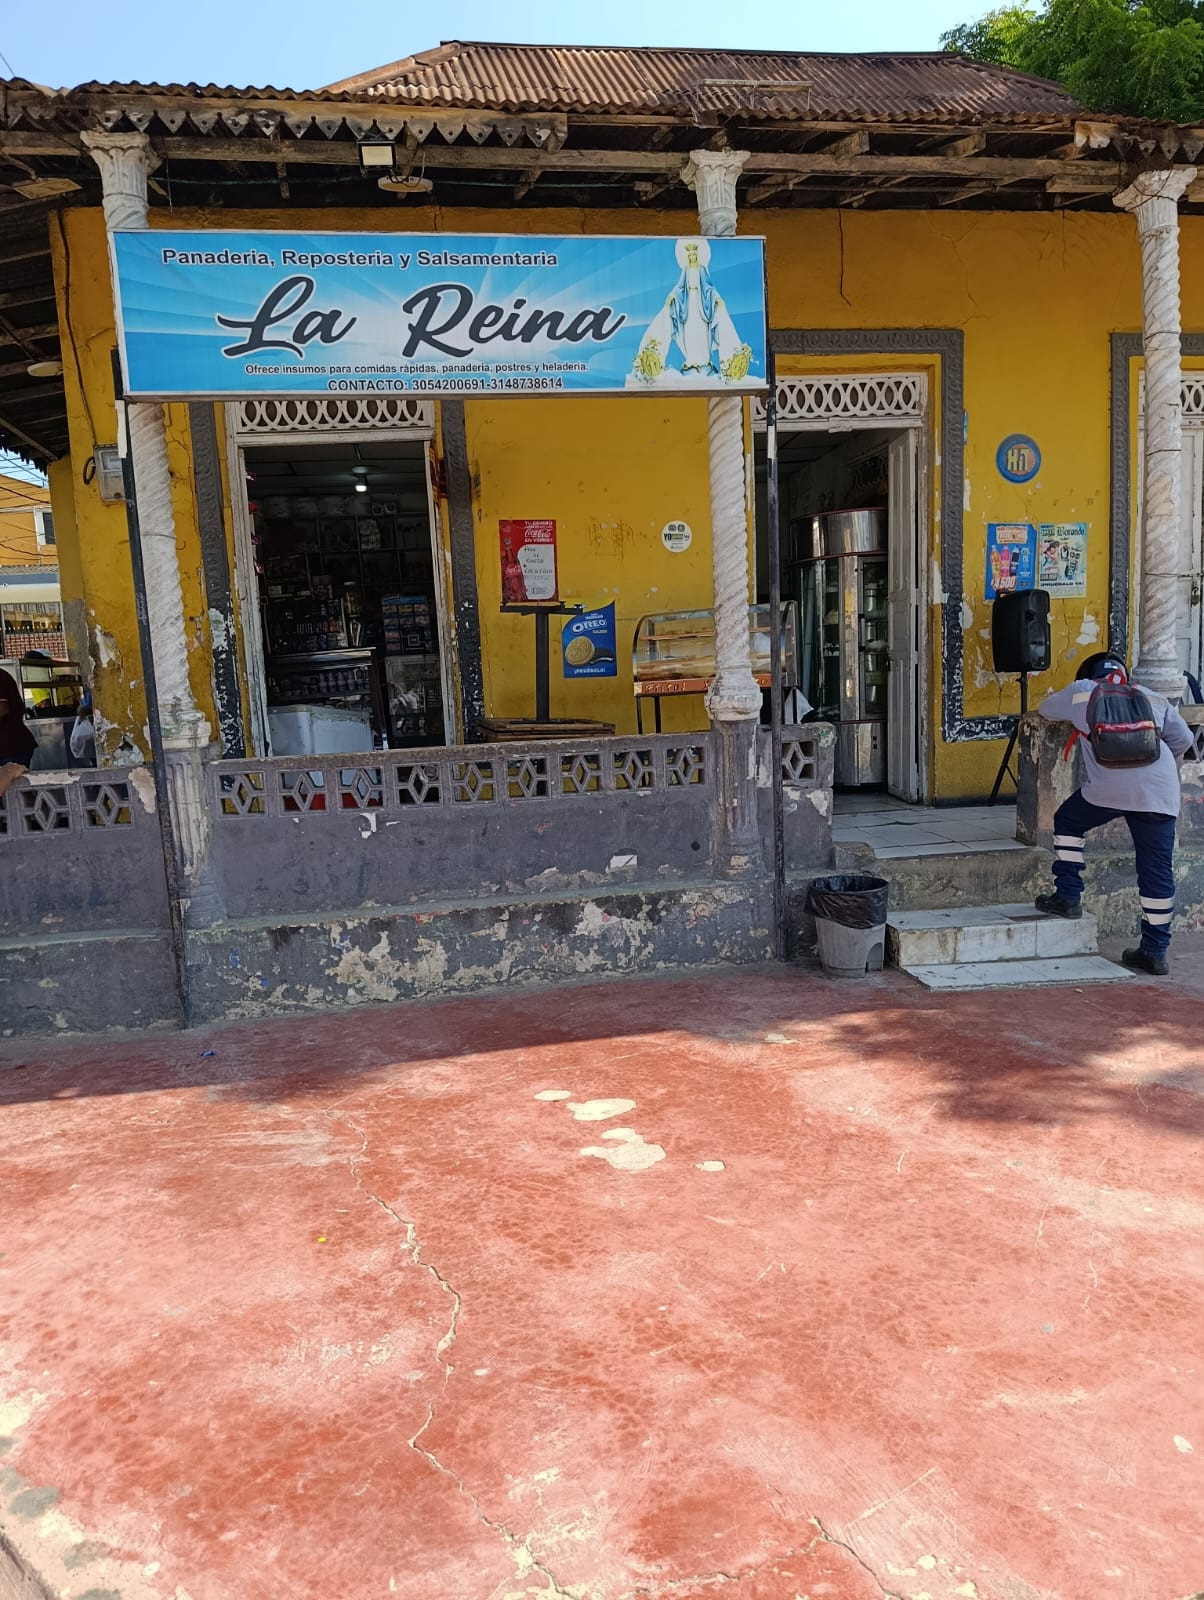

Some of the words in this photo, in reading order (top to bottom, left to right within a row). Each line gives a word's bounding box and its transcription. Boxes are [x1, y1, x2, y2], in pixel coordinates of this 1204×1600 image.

[162, 249, 275, 267] Panaderia,
[282, 250, 393, 268] Reposteria
[399, 253, 411, 268] y
[418, 250, 558, 266] Salsamentaria
[217, 276, 357, 358] La
[402, 283, 627, 358] Reina
[246, 364, 280, 374] Ofrece
[283, 364, 326, 374] insumos
[329, 366, 351, 376] para
[354, 364, 397, 374] comidas
[495, 363, 532, 374] postres
[534, 364, 541, 374] y
[328, 379, 408, 391] CONTACTO:
[412, 378, 563, 391] 3054200691-3148738614
[572, 619, 606, 633] OREO
